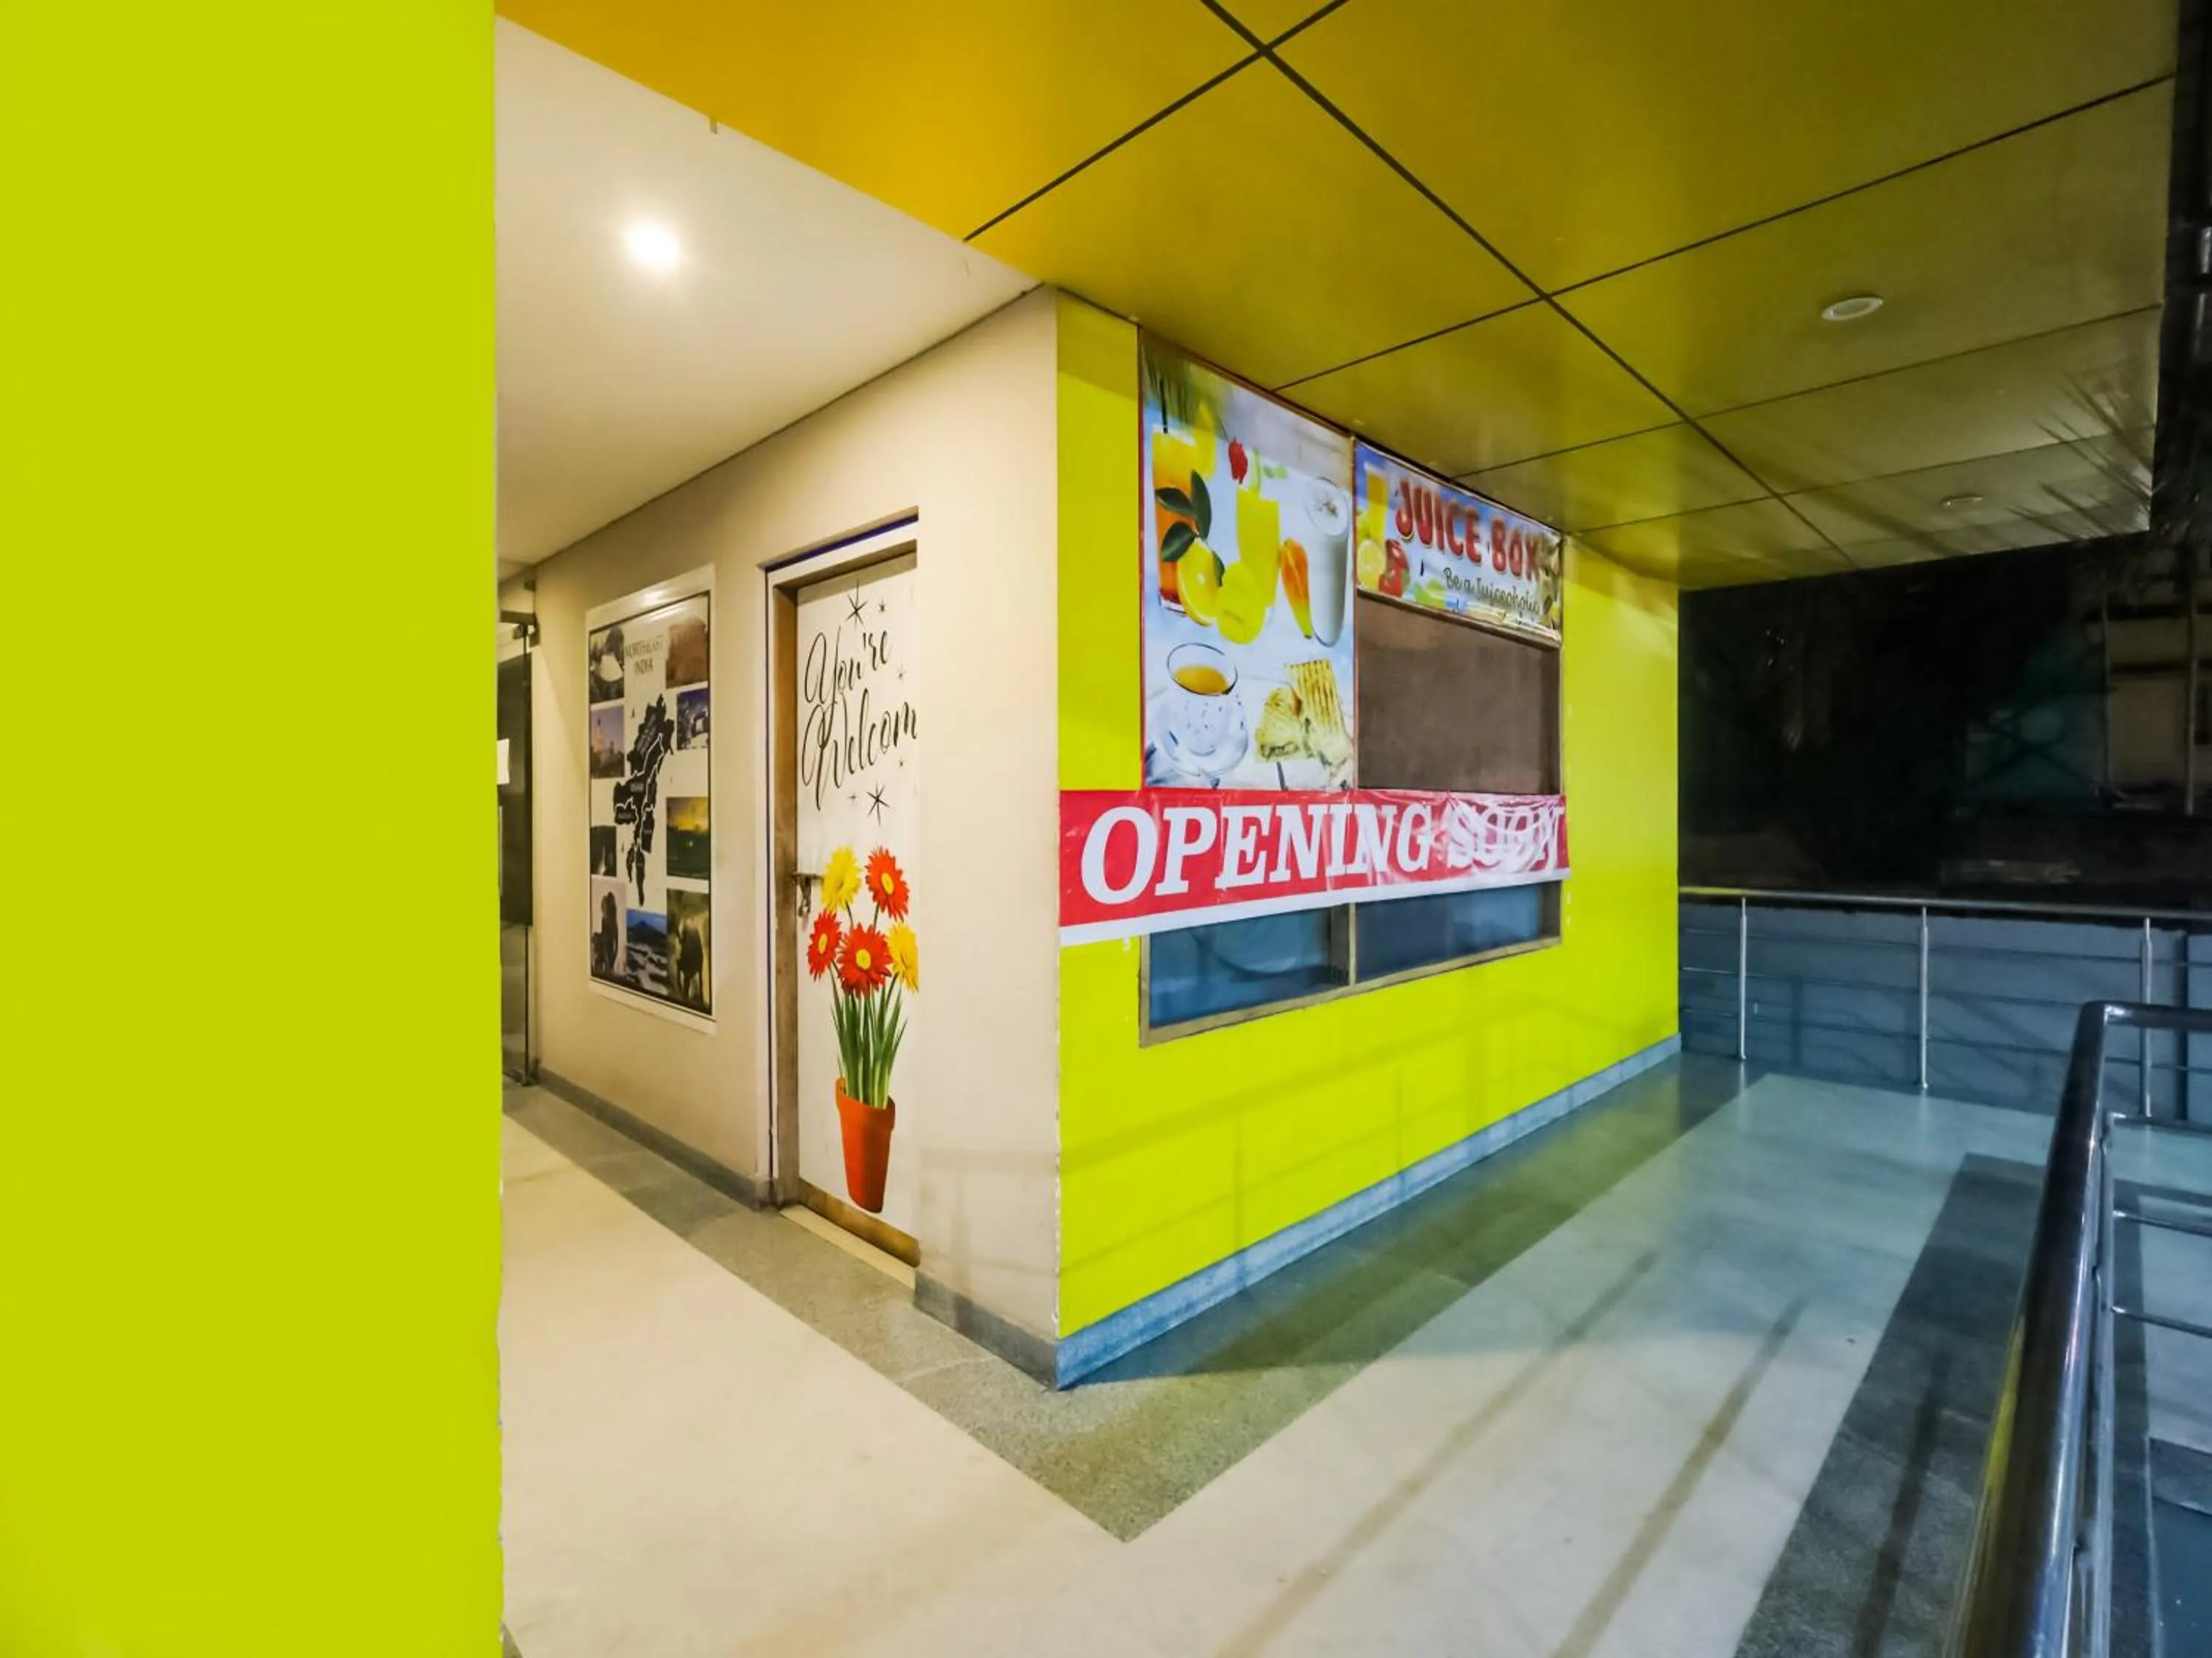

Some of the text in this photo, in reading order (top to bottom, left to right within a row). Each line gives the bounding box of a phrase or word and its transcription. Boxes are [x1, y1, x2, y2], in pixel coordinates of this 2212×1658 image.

[1395, 480, 1540, 582] JUICE BOX
[1443, 566, 1462, 590] Be
[1080, 803, 1433, 904] OPENING
